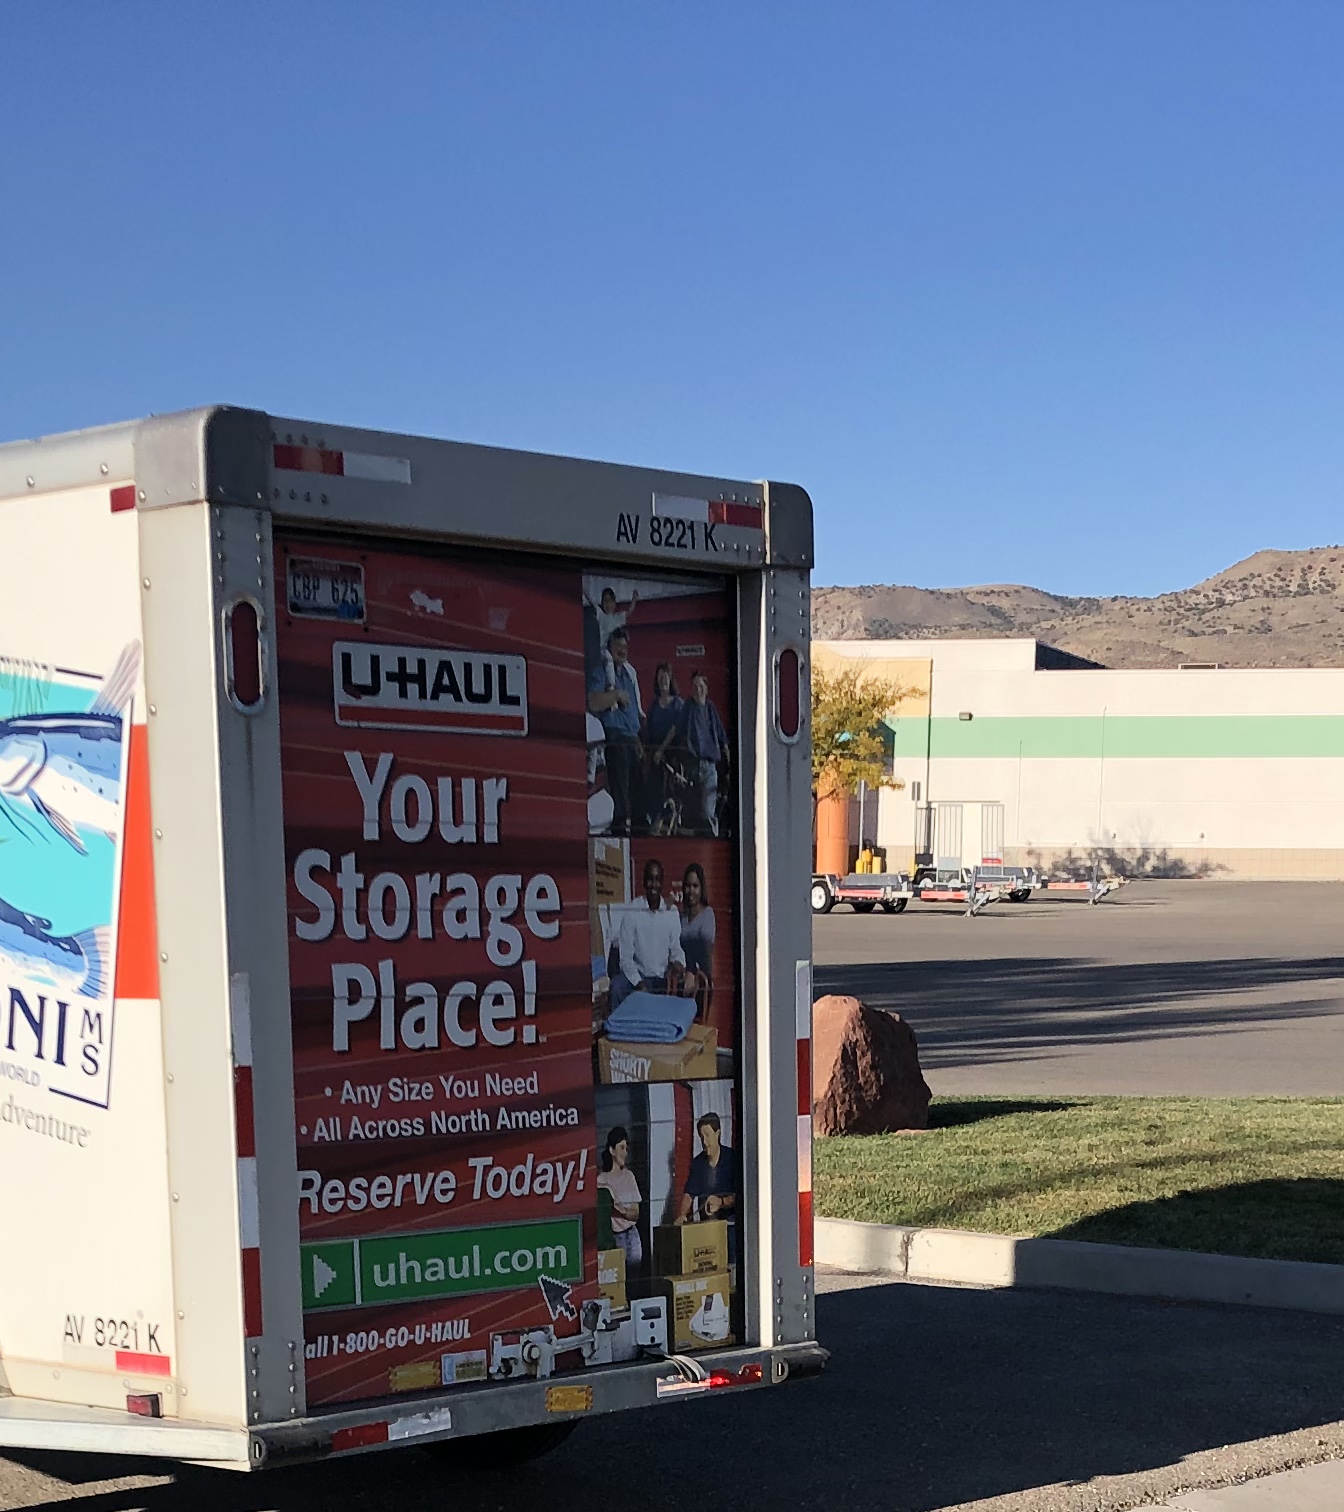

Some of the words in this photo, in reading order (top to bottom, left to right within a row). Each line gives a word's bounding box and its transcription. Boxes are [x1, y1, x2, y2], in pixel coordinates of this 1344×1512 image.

[616, 512, 640, 544] AV
[650, 518, 697, 550] 8221
[704, 523, 719, 552] K
[341, 651, 521, 706] U-HAUL
[344, 751, 507, 845] Your
[293, 849, 561, 966] Storage
[331, 959, 539, 1052] Place!
[340, 1079, 382, 1108] Any
[388, 1076, 435, 1103] Size
[439, 1074, 480, 1101] You
[485, 1071, 540, 1098] Need
[314, 1116, 342, 1142] All
[349, 1112, 425, 1139] Across
[431, 1109, 490, 1136] North
[496, 1105, 579, 1131] America
[297, 1169, 457, 1215] Reserve
[467, 1149, 588, 1205] Today!
[372, 1239, 568, 1288] uhaul.com
[64, 1313, 84, 1343] AV
[94, 1317, 138, 1351] 8221
[148, 1321, 161, 1353] K
[305, 1336, 329, 1360] all
[332, 1319, 471, 1356] 1-800-GO-U-HAUL
